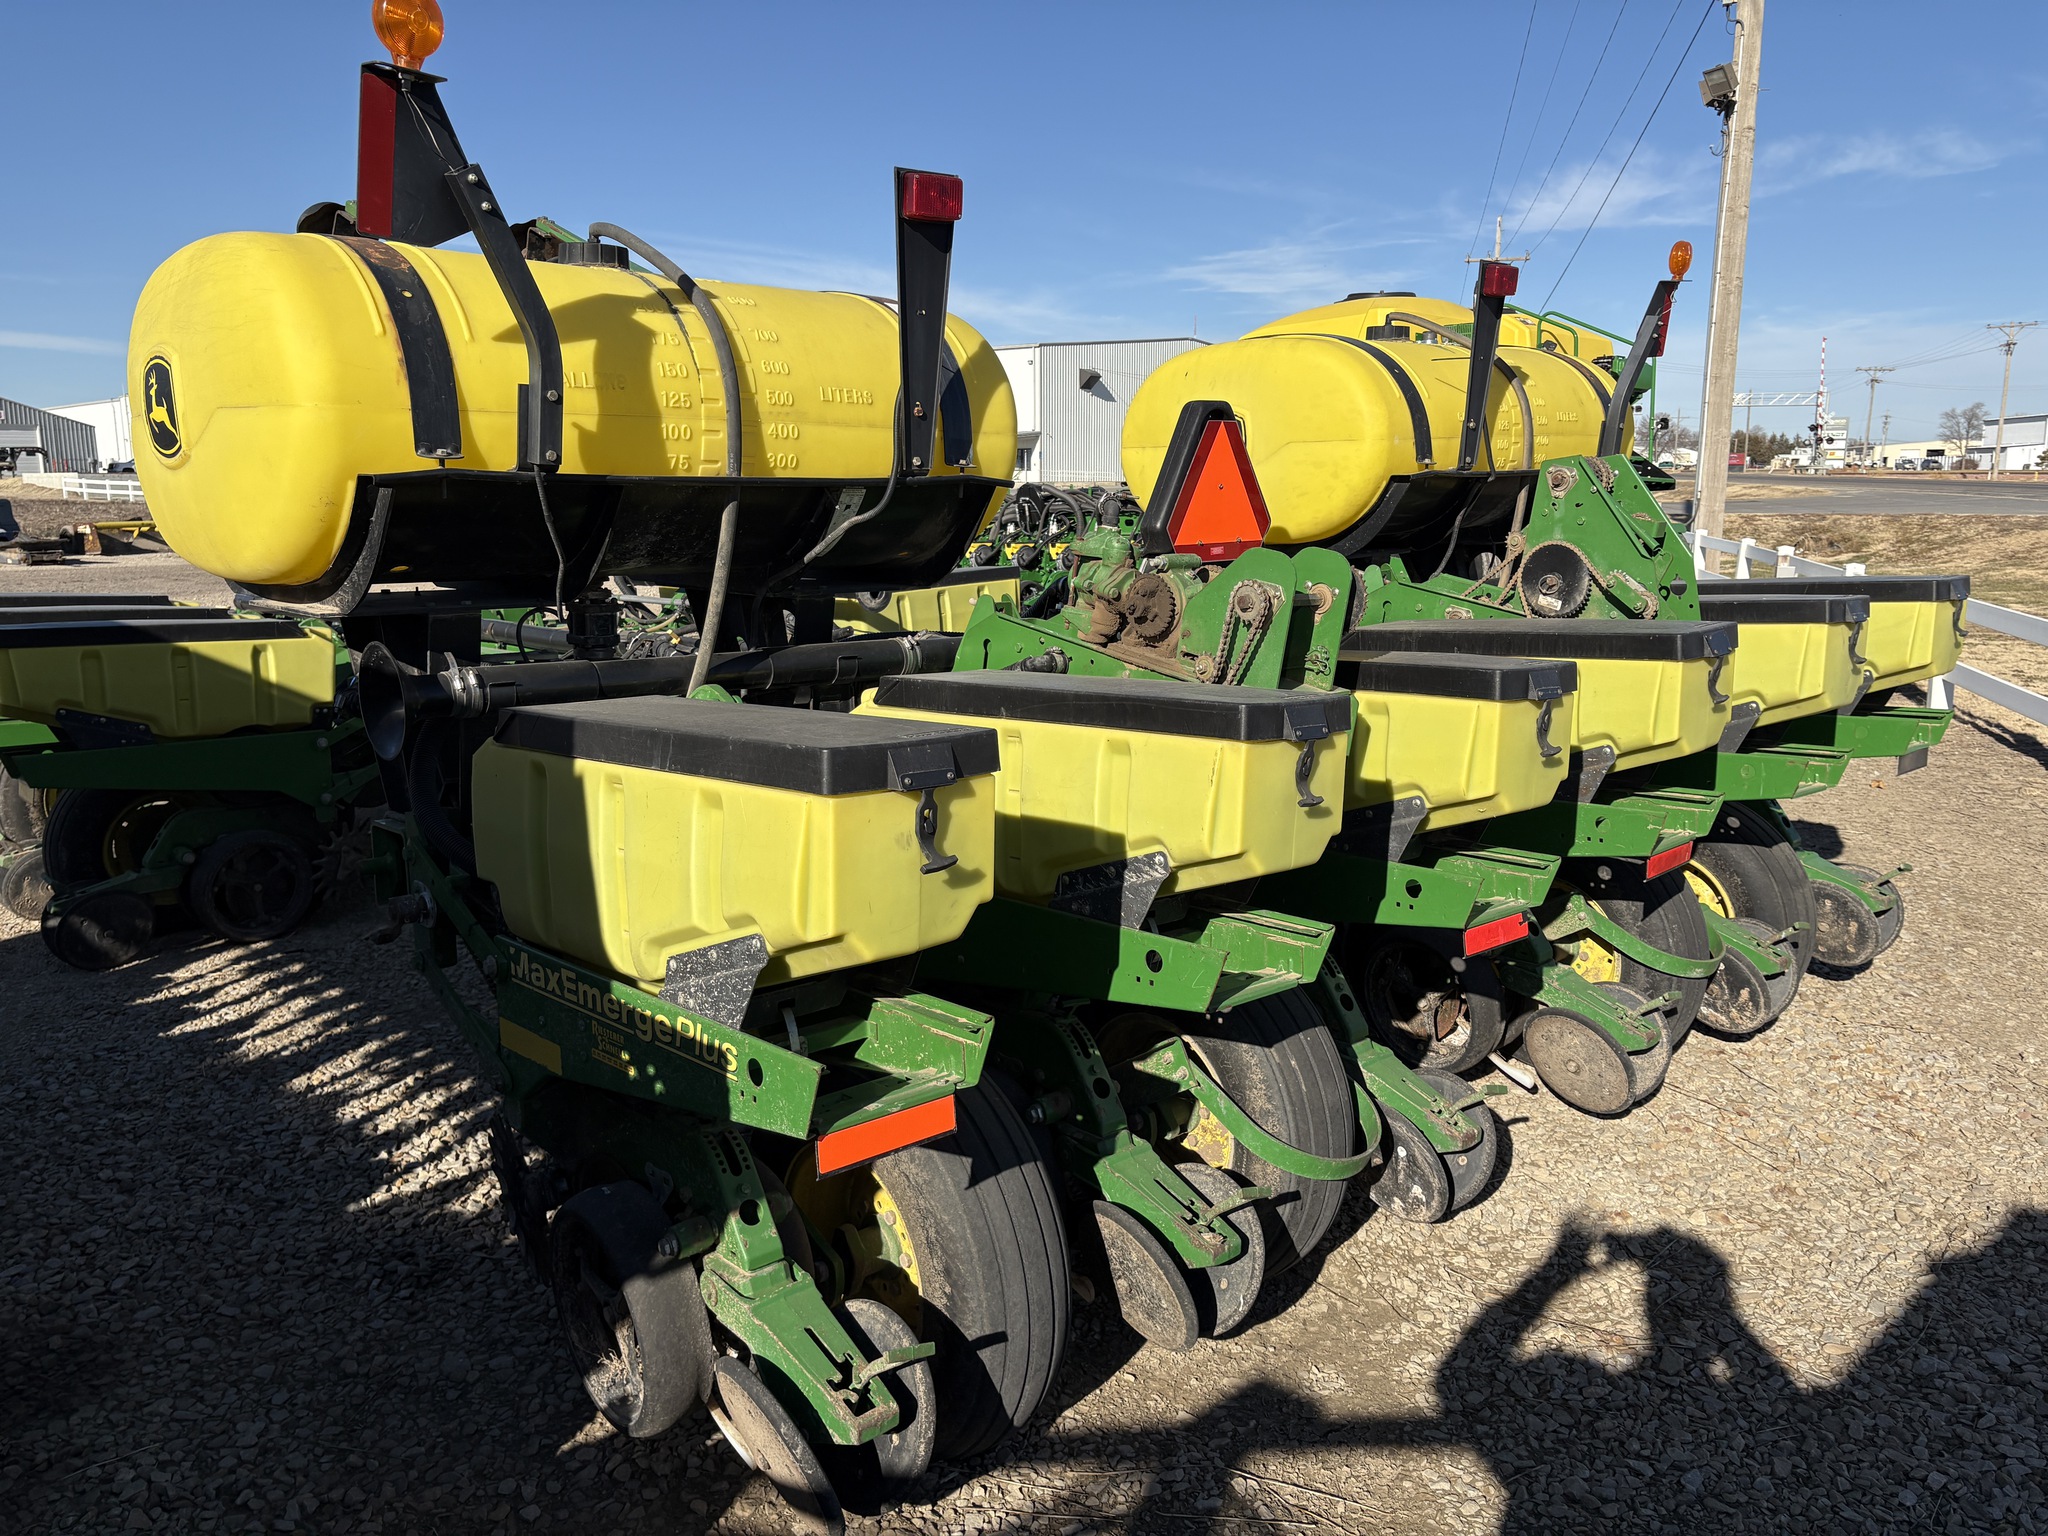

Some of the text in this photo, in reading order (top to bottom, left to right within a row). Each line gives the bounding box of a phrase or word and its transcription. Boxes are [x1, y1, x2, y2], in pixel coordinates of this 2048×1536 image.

[656, 361, 689, 379] 150
[760, 359, 790, 375] 600
[660, 390, 692, 409] 125
[765, 389, 794, 406] 500
[819, 385, 874, 406] LITERS
[661, 422, 692, 440] 100
[767, 422, 799, 440] 400
[667, 453, 691, 471] 75
[767, 452, 798, 469] 300
